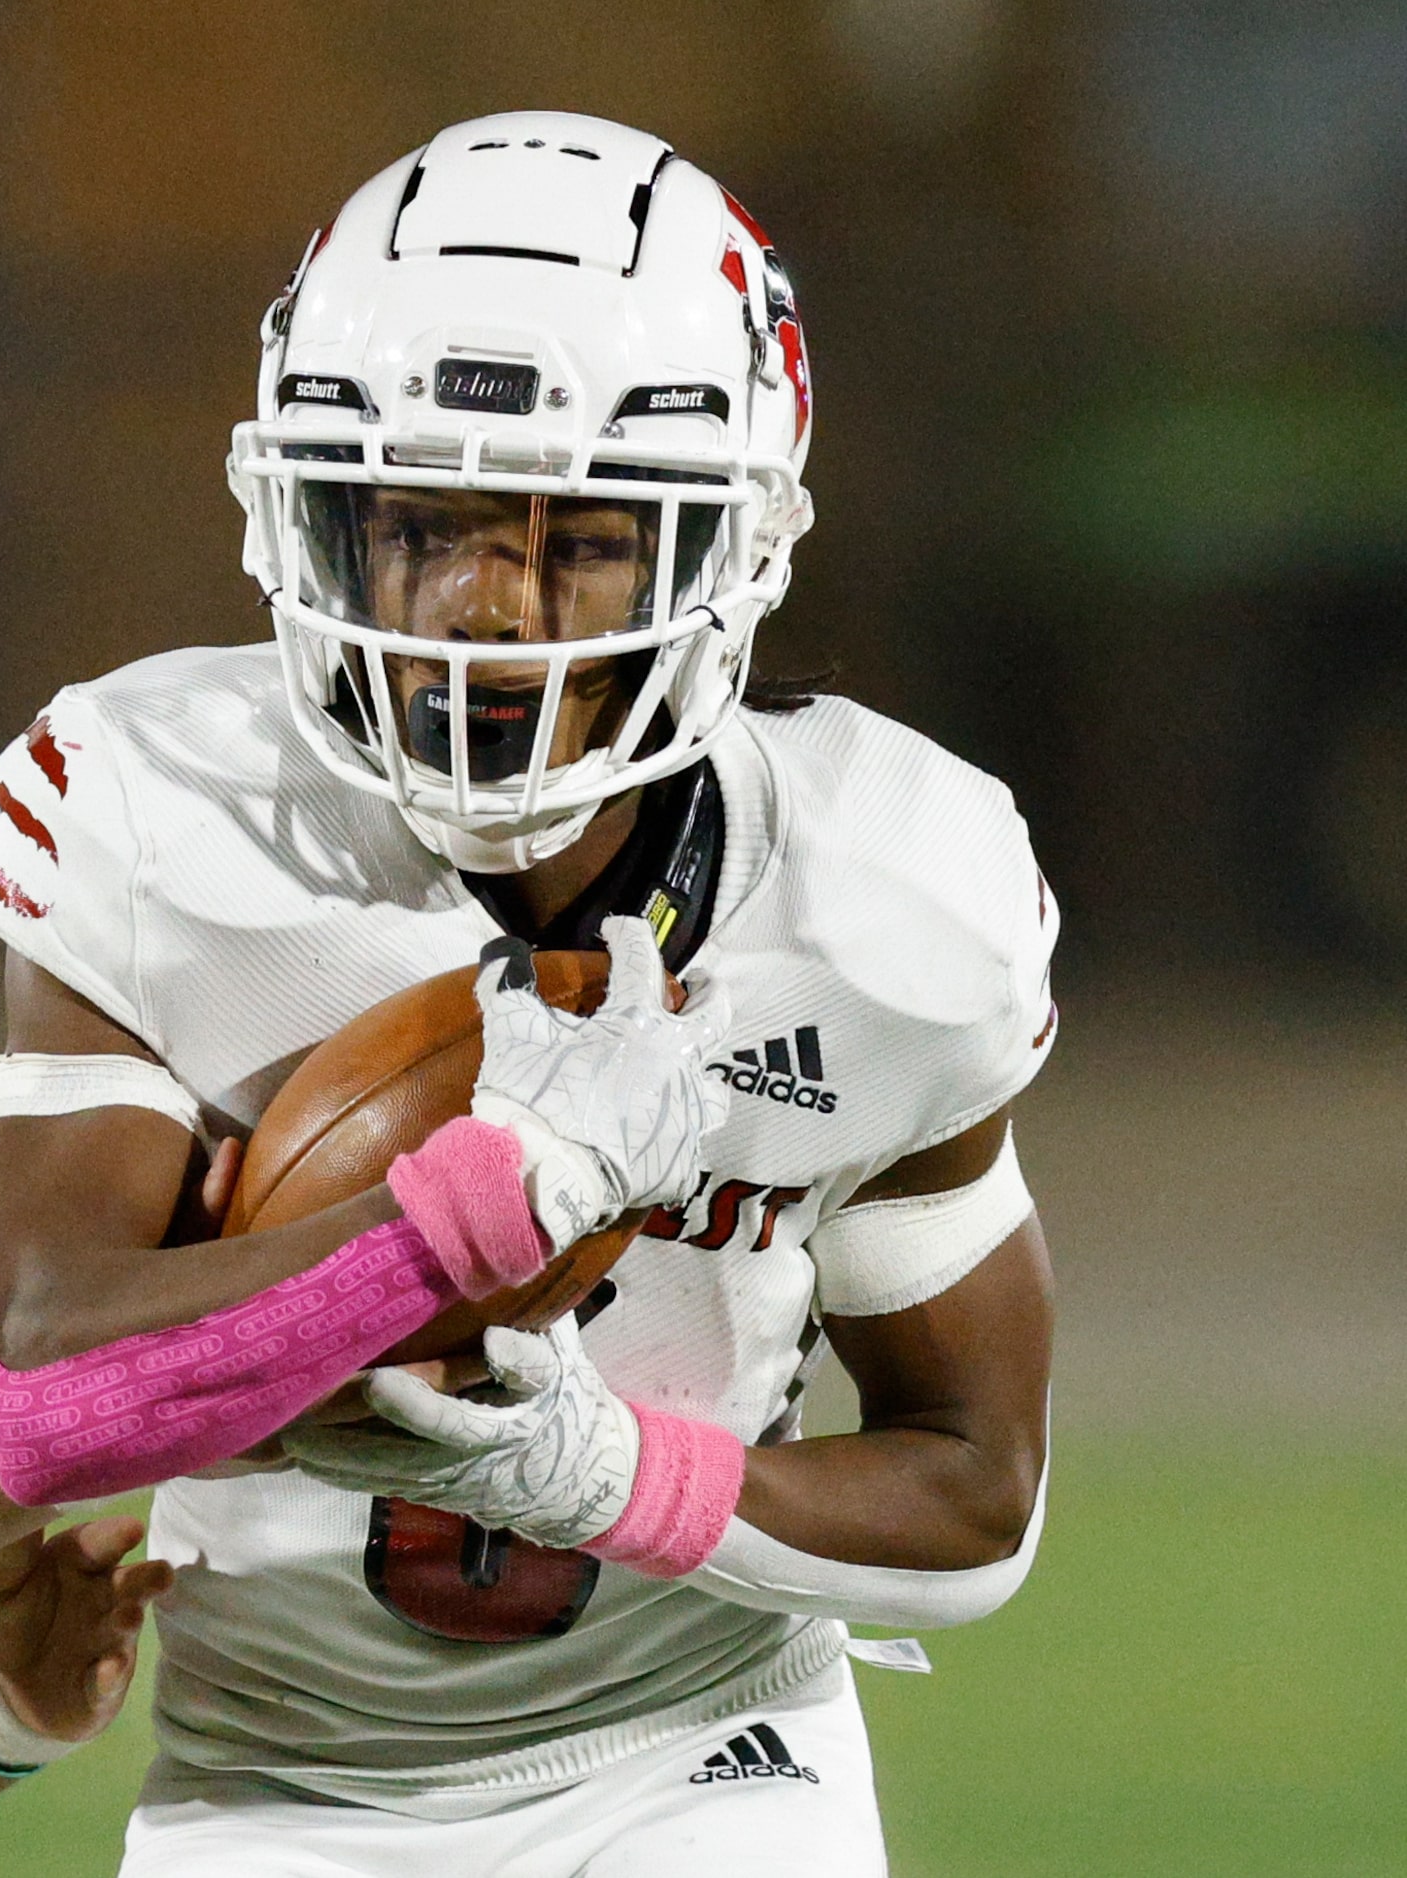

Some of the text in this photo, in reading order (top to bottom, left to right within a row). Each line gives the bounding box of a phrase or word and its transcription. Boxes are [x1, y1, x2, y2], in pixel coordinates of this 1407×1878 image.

[295, 378, 342, 400] schutt
[648, 388, 706, 409] schutt
[705, 1062, 839, 1114] adidas
[244, 1294, 316, 1336] BATTLE
[144, 1338, 216, 1369] BATTLE
[51, 1366, 119, 1402] BATTLE
[5, 1411, 72, 1438] BATTLE
[57, 1416, 138, 1456] BATTLE
[689, 1763, 820, 1784] adidas
